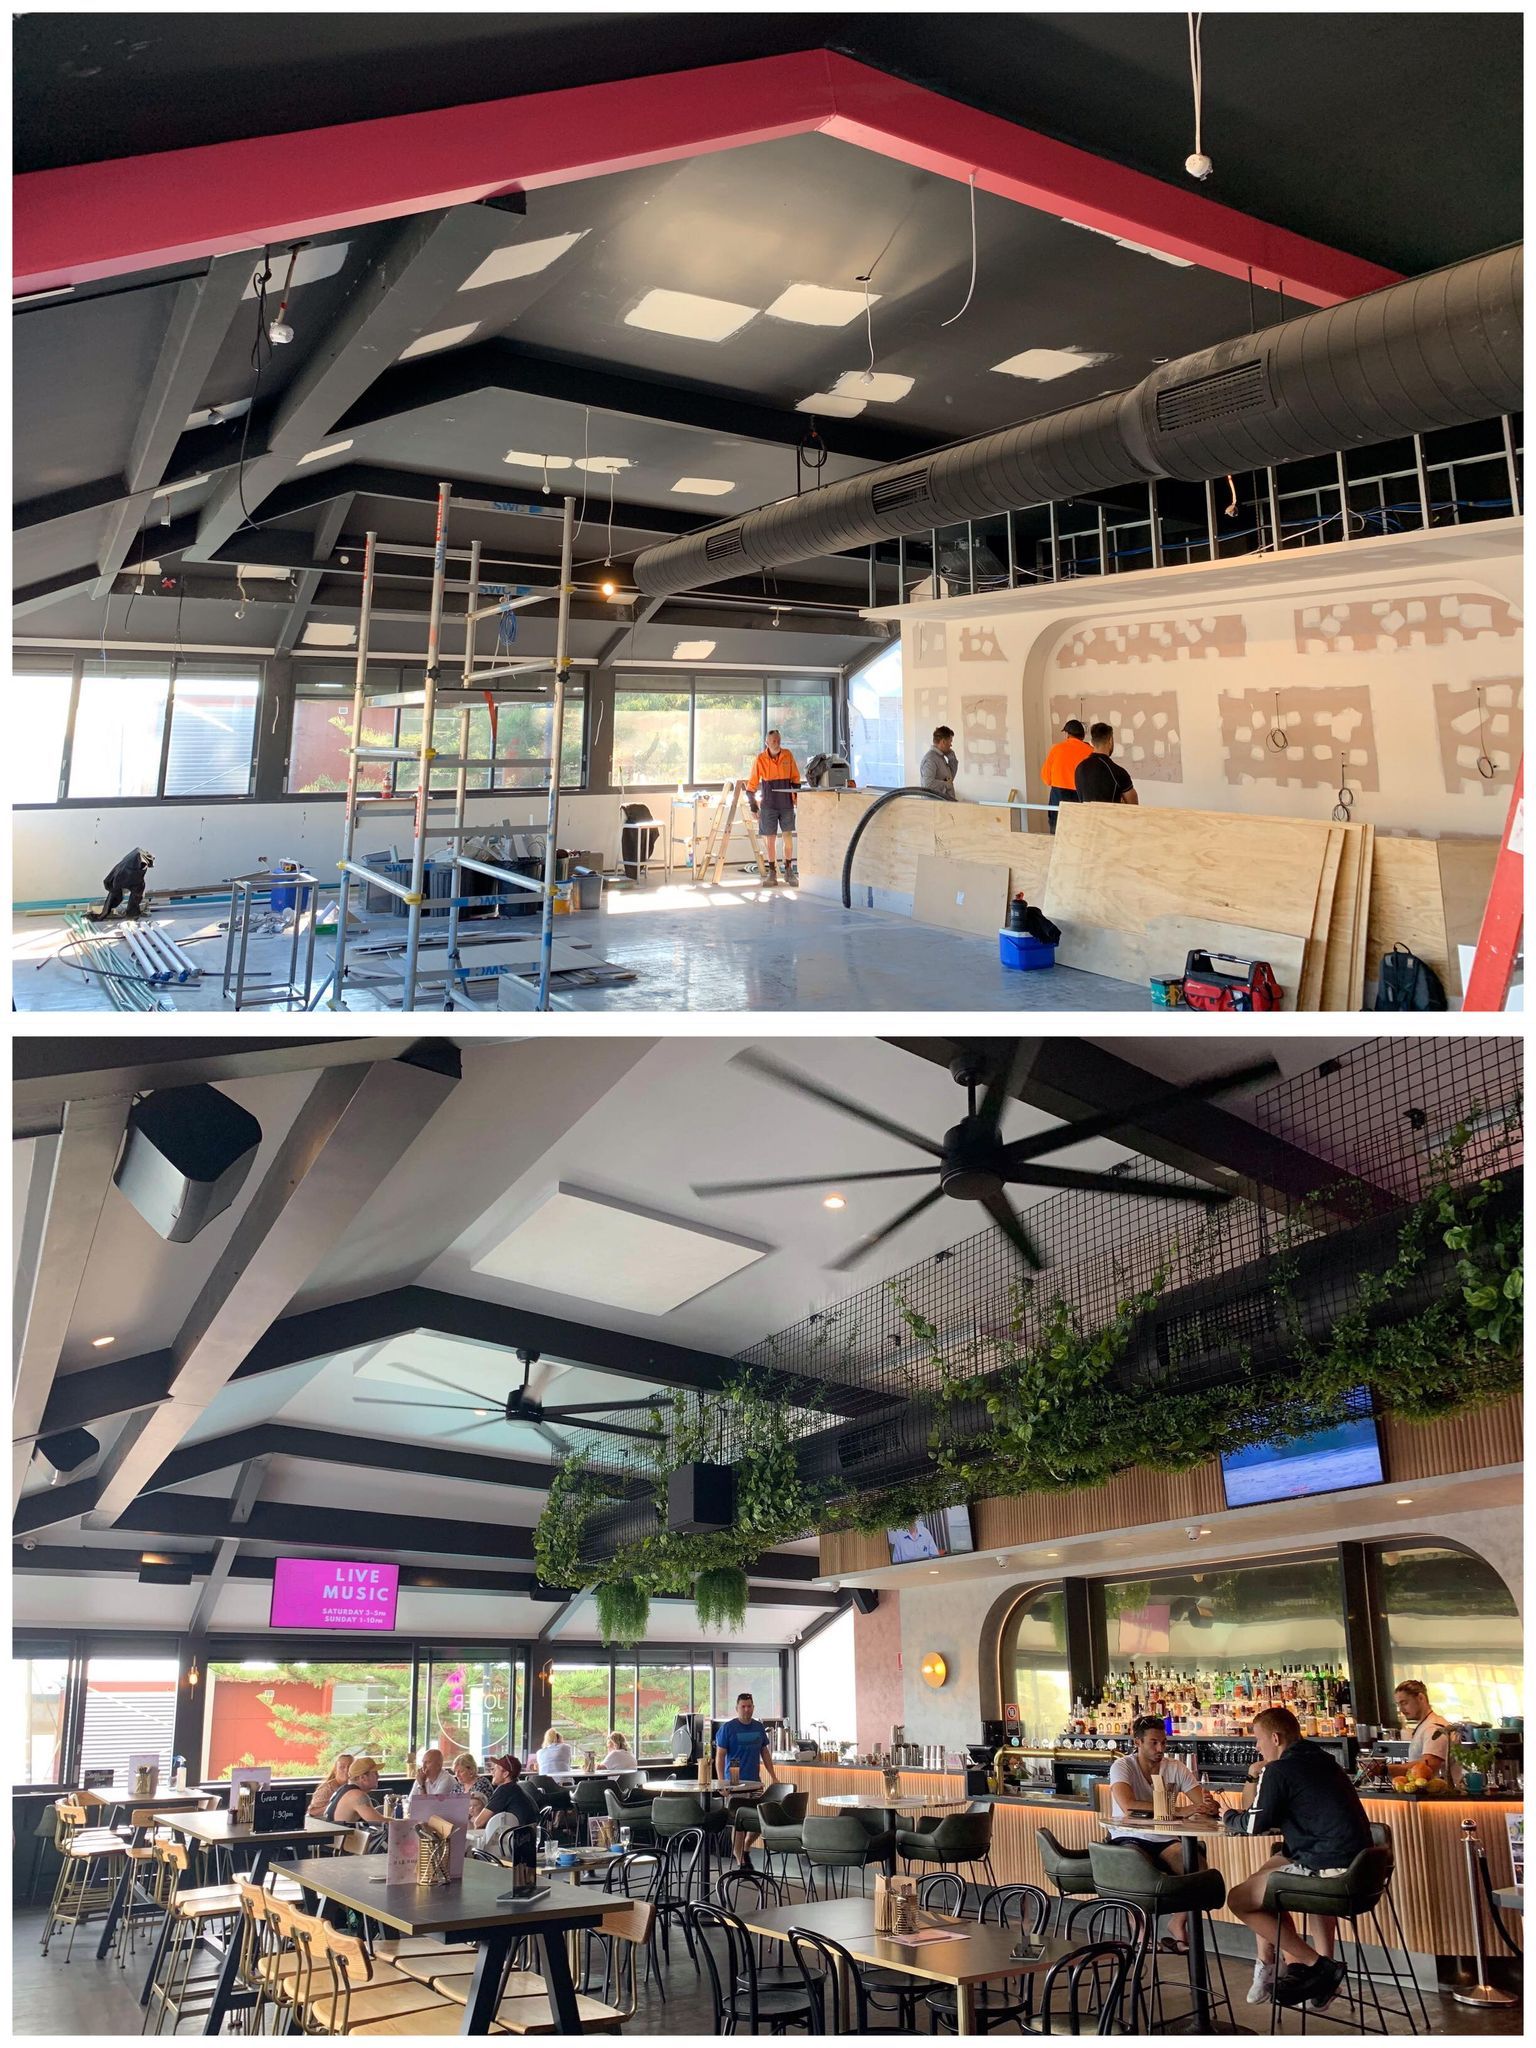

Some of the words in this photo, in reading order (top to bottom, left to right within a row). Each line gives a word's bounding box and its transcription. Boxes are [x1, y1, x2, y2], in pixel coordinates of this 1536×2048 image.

[479, 585, 511, 595] SWC
[336, 1568, 380, 1583] LIVE
[323, 1585, 389, 1601] MUSIC
[322, 1608, 364, 1616] SATURDAY
[324, 1615, 357, 1623] SUNDAY
